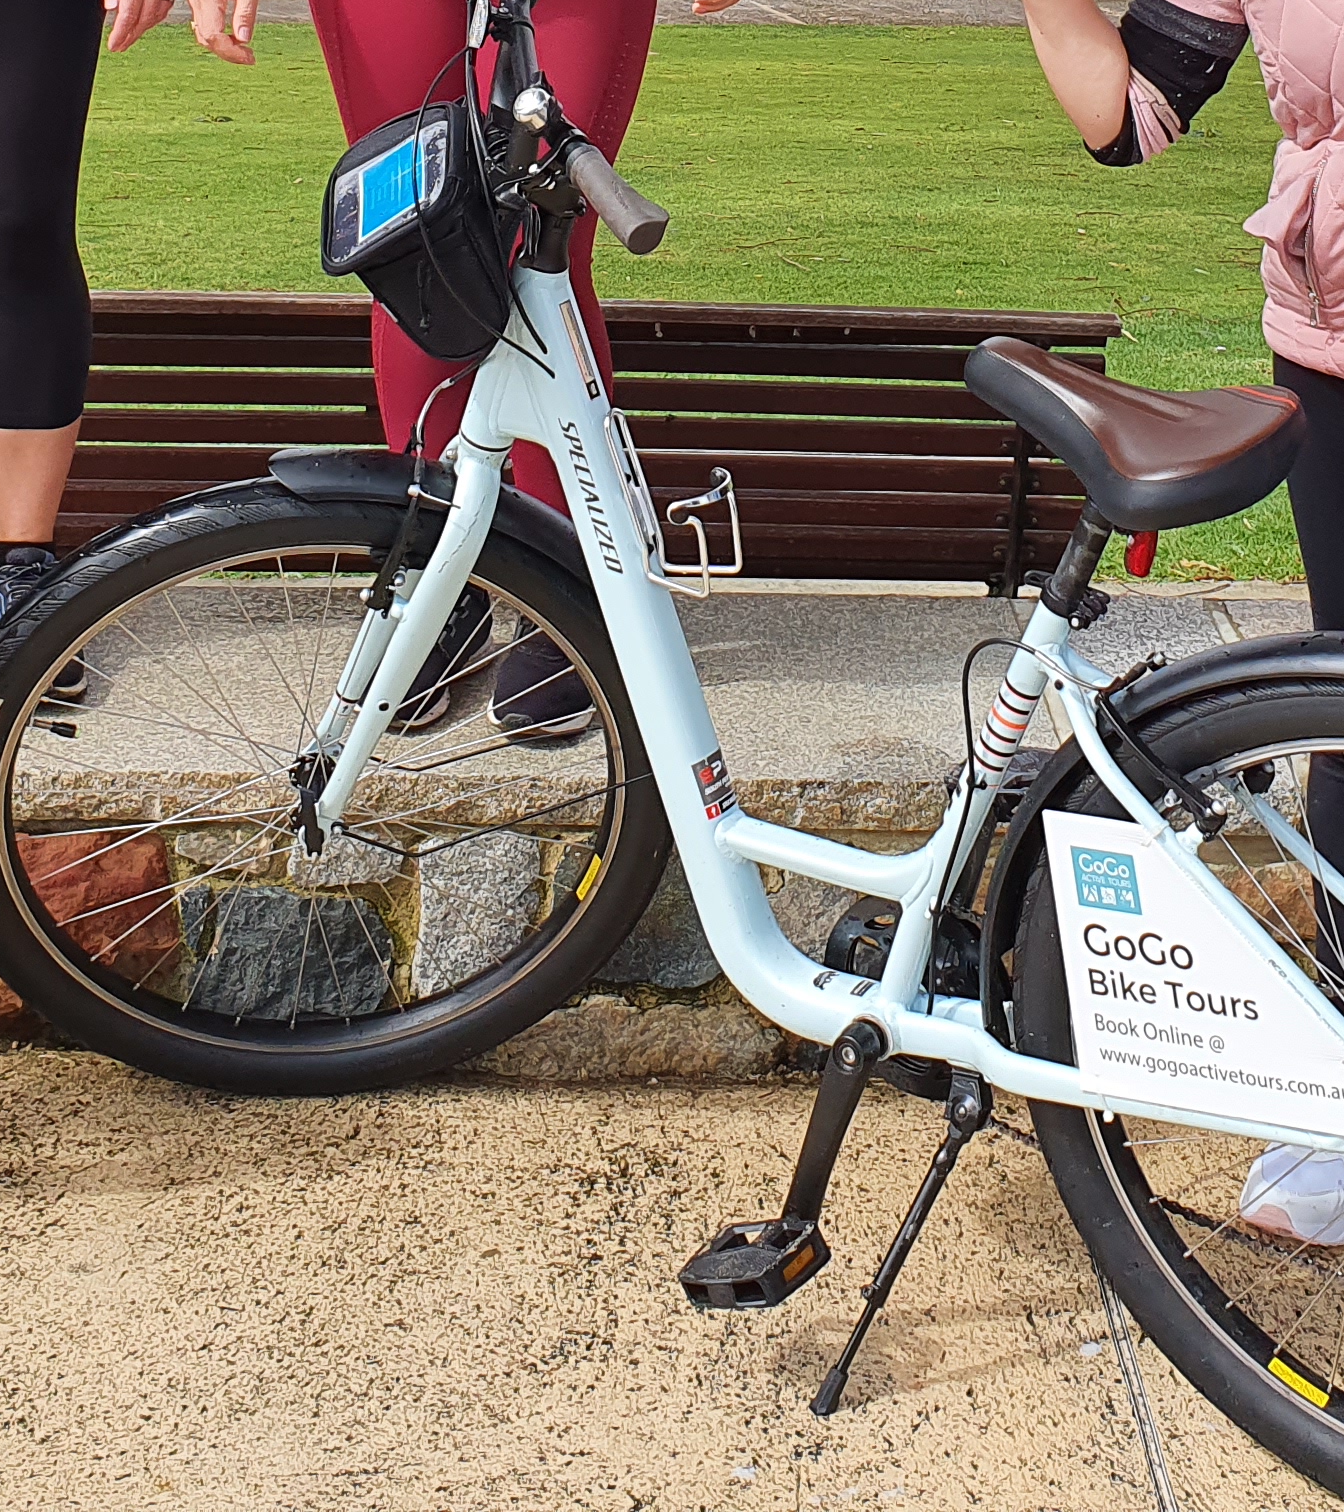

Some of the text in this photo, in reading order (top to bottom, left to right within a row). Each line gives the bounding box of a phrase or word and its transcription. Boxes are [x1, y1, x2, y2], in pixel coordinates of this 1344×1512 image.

[558, 418, 624, 574] SPECIALIZED
[1078, 853, 1130, 878] GoGo
[1083, 923, 1194, 970] GoGo
[1088, 968, 1259, 1021] Bike Tours
[1094, 1013, 1225, 1054] Book Online @
